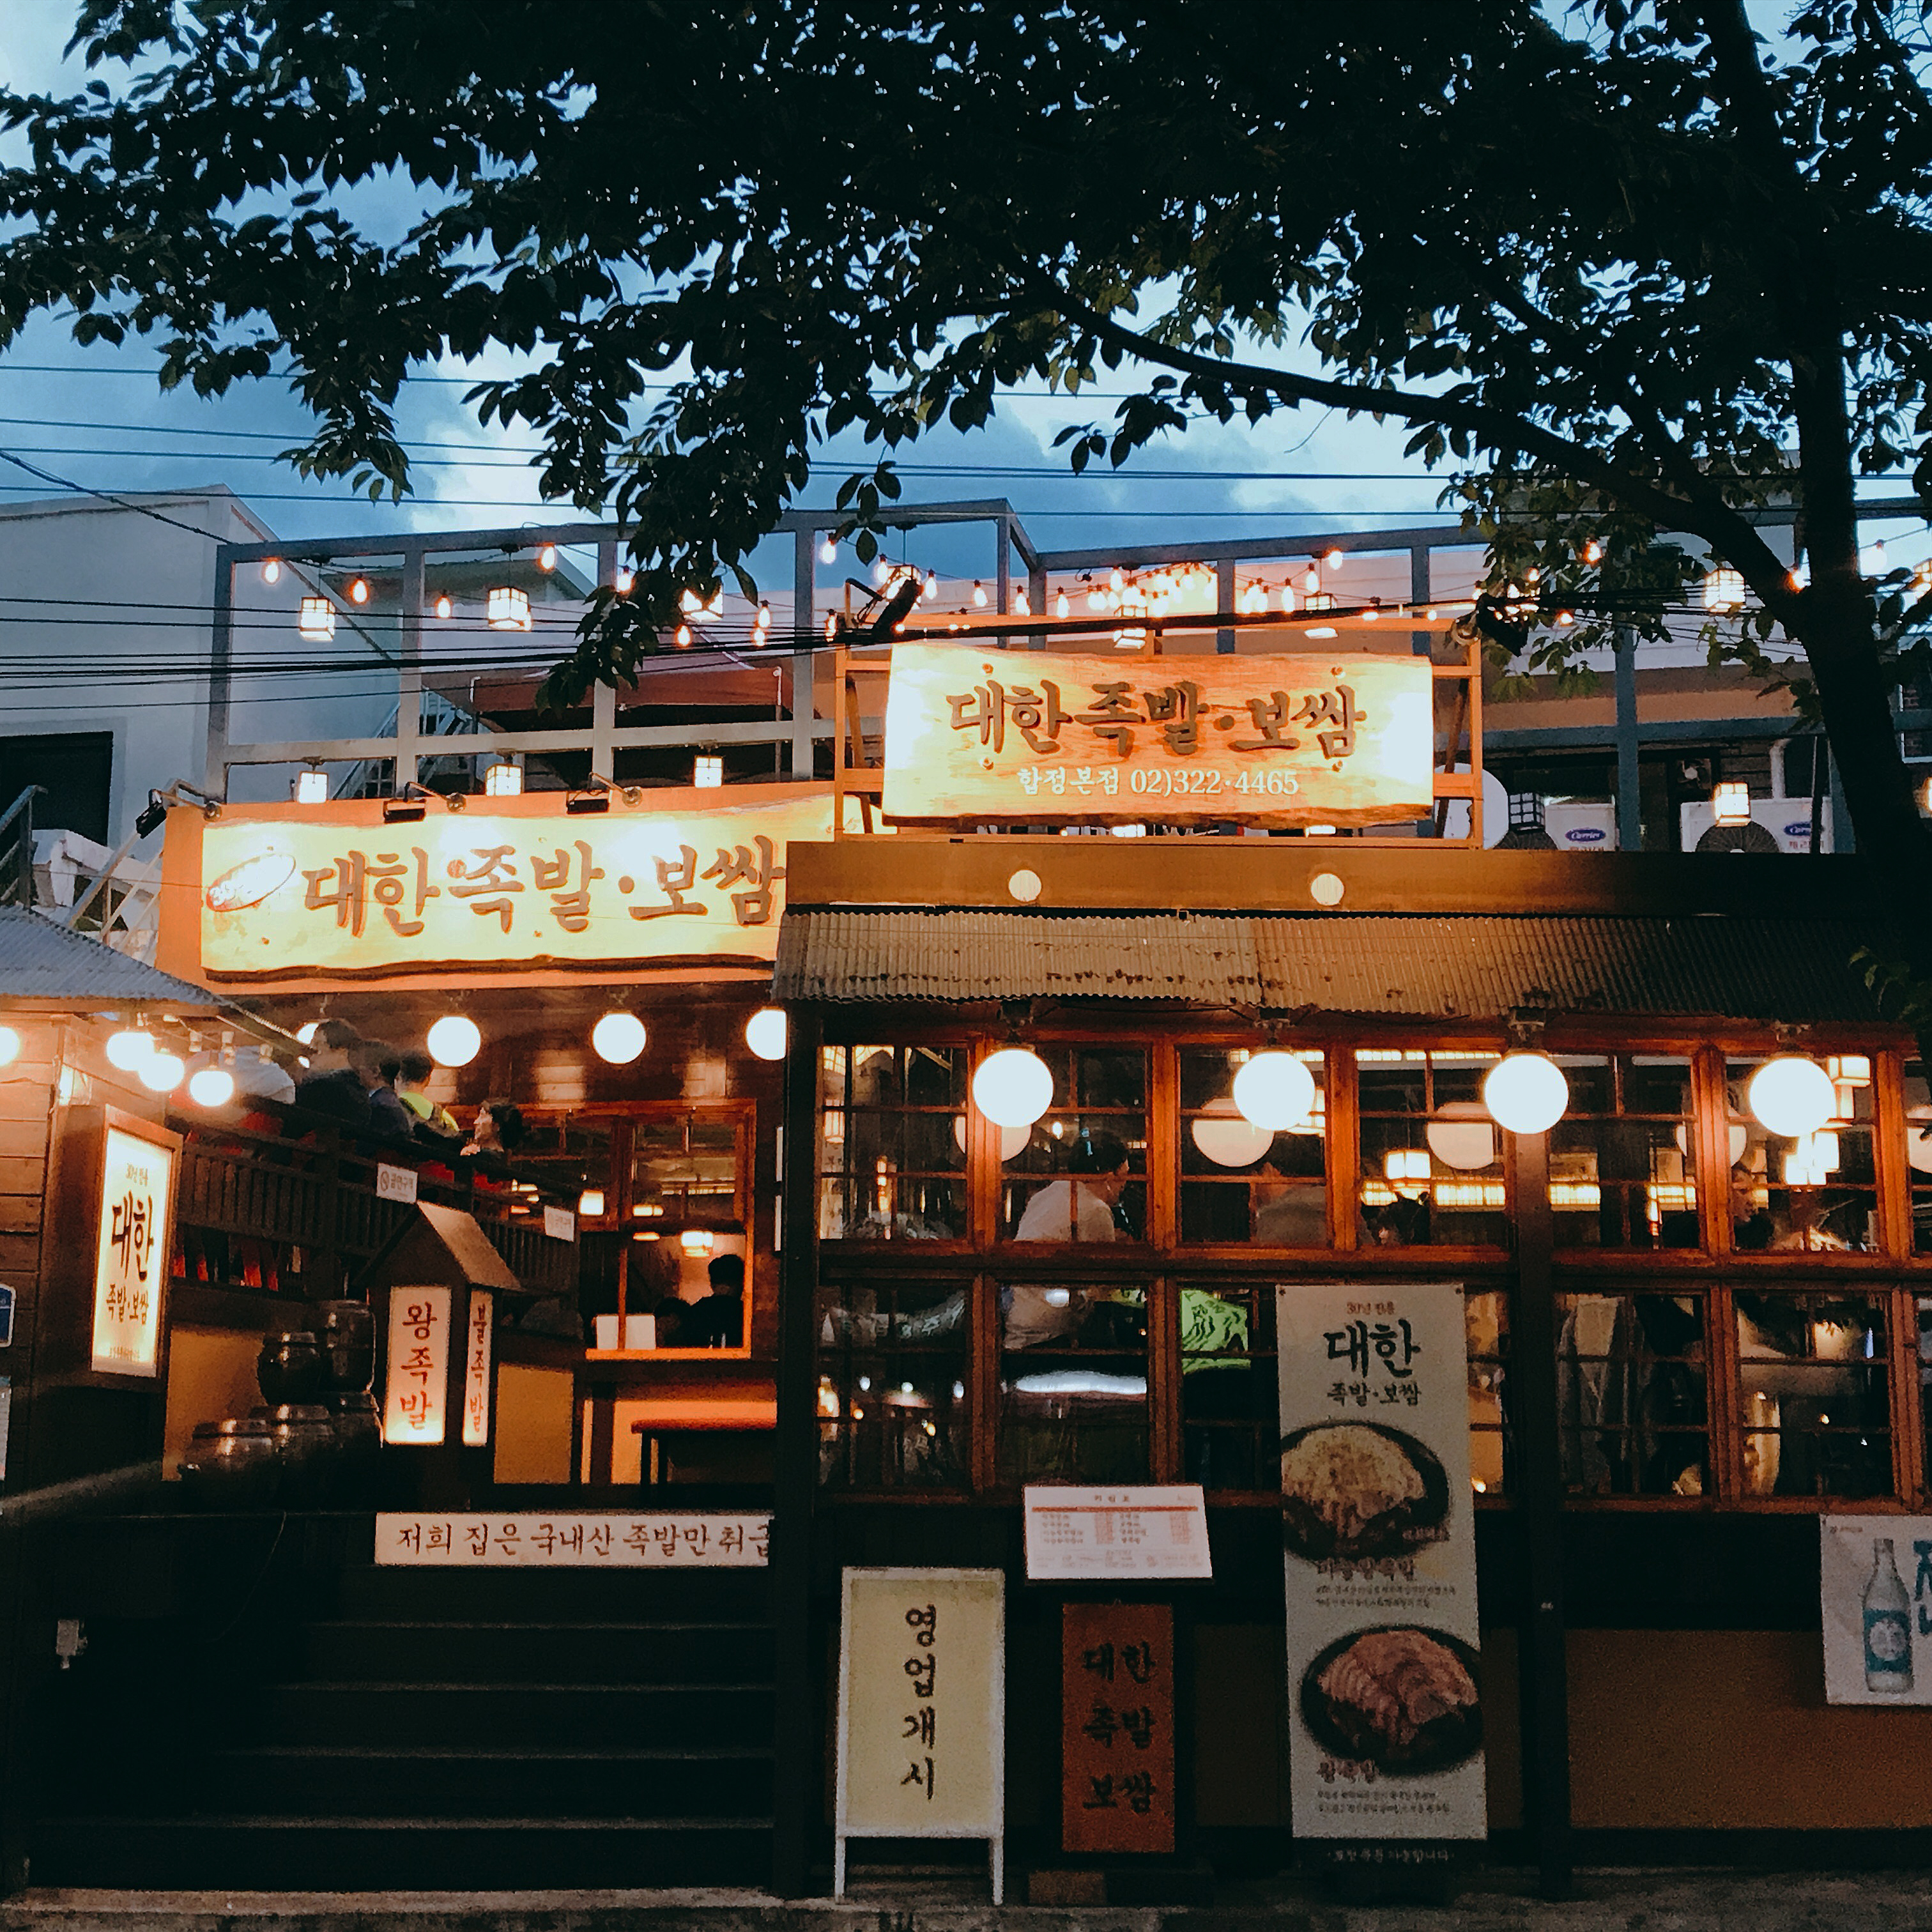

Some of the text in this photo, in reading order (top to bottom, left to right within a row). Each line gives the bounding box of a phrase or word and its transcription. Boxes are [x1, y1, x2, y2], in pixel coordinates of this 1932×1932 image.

[111, 1190, 154, 1282] 대한
[106, 1284, 148, 1325] 족발·보쌈
[400, 1301, 438, 1430] 왕족발
[1323, 1318, 1422, 1377] 대한
[1327, 1381, 1422, 1407] 족발·보쌈
[399, 1522, 452, 1556] 저희
[463, 1523, 521, 1556] 집은
[530, 1523, 614, 1557] 국내산
[623, 1523, 711, 1557] 족발만
[1082, 1641, 1156, 1683] 대한
[901, 1604, 936, 1800] 영업개시
[1082, 1706, 1156, 1749] 족발
[1082, 1771, 1156, 1814] 보쌈
